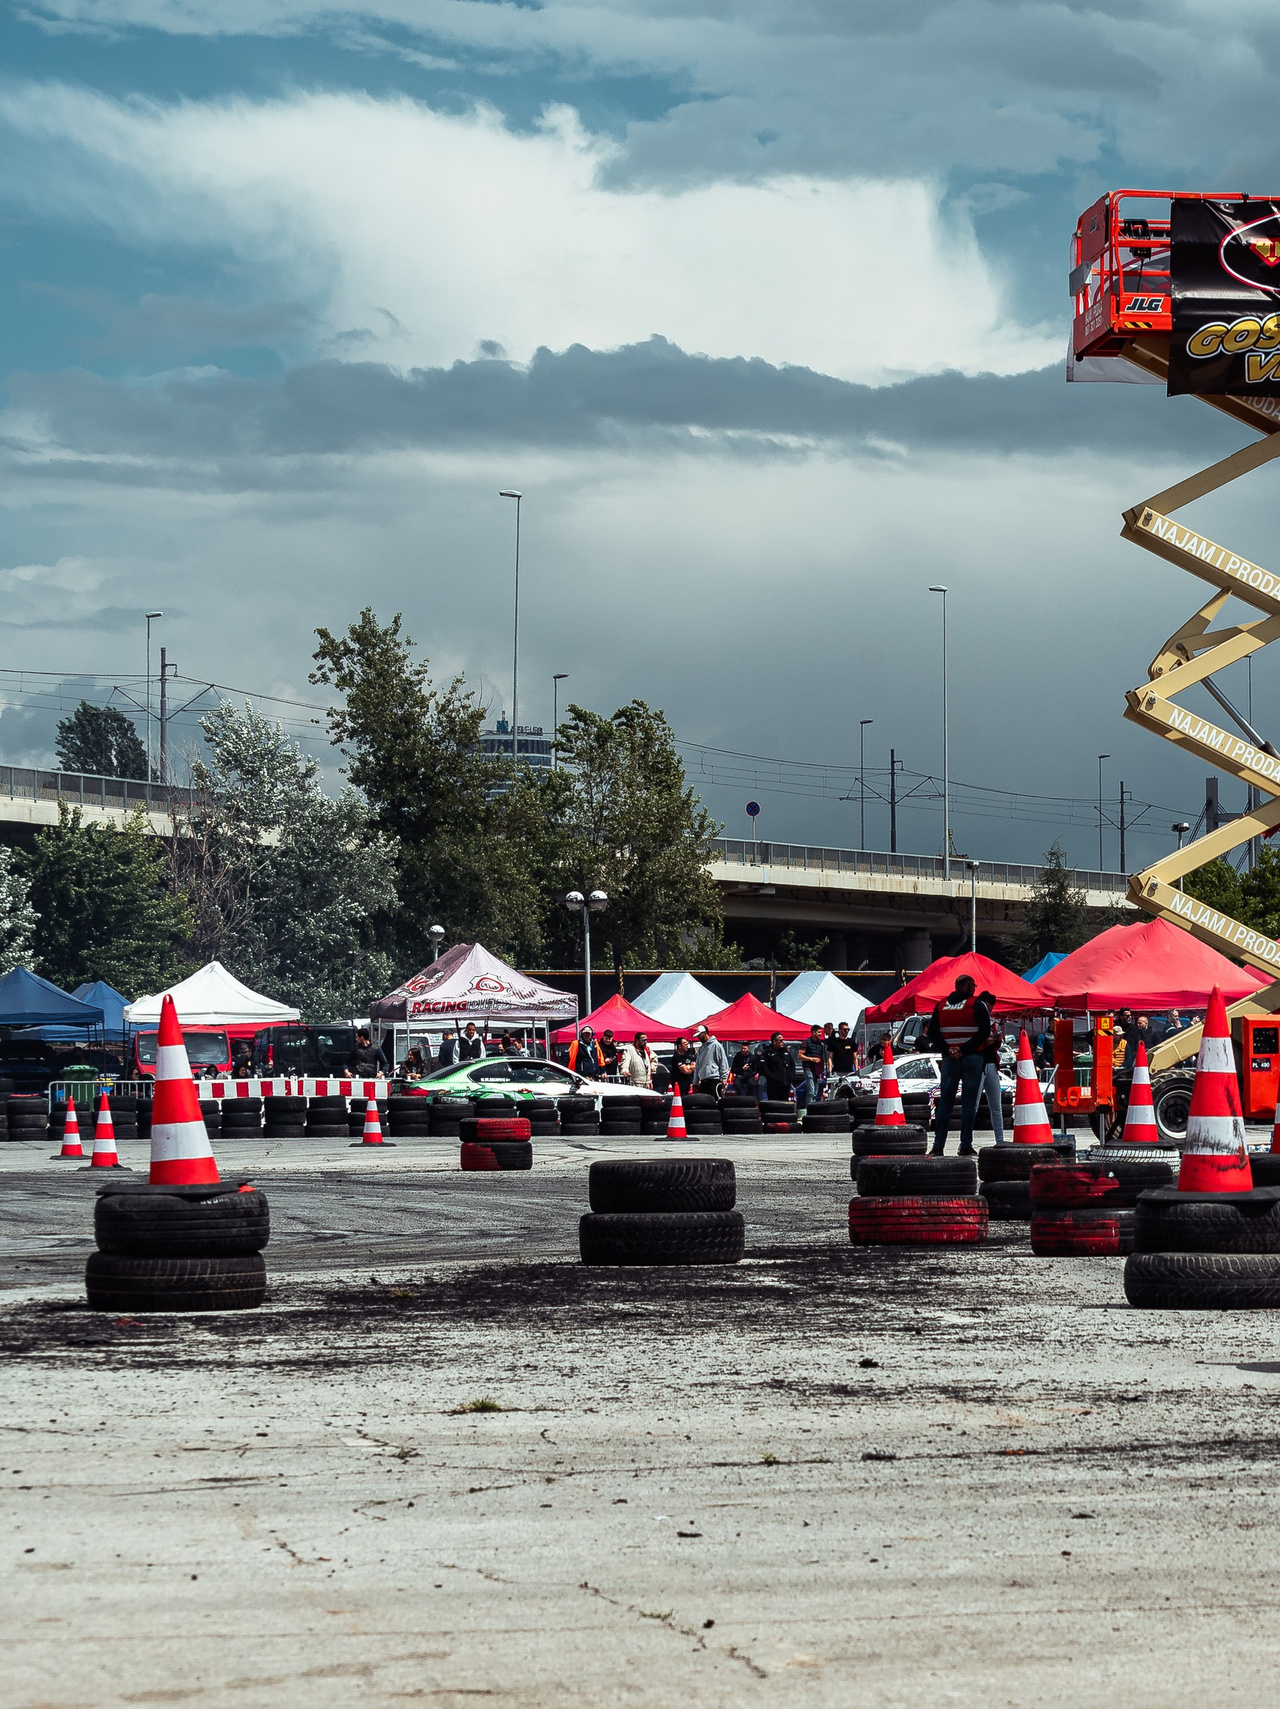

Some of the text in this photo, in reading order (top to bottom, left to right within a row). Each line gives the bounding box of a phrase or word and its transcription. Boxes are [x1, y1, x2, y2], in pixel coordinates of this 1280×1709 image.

[1125, 297, 1163, 313] JLG
[1152, 518, 1217, 563] NAJAM
[1215, 551, 1226, 567] I
[1168, 708, 1226, 749] NAJAM
[1223, 738, 1233, 753] I
[1170, 893, 1227, 934] NAJAM
[1225, 922, 1235, 938] I
